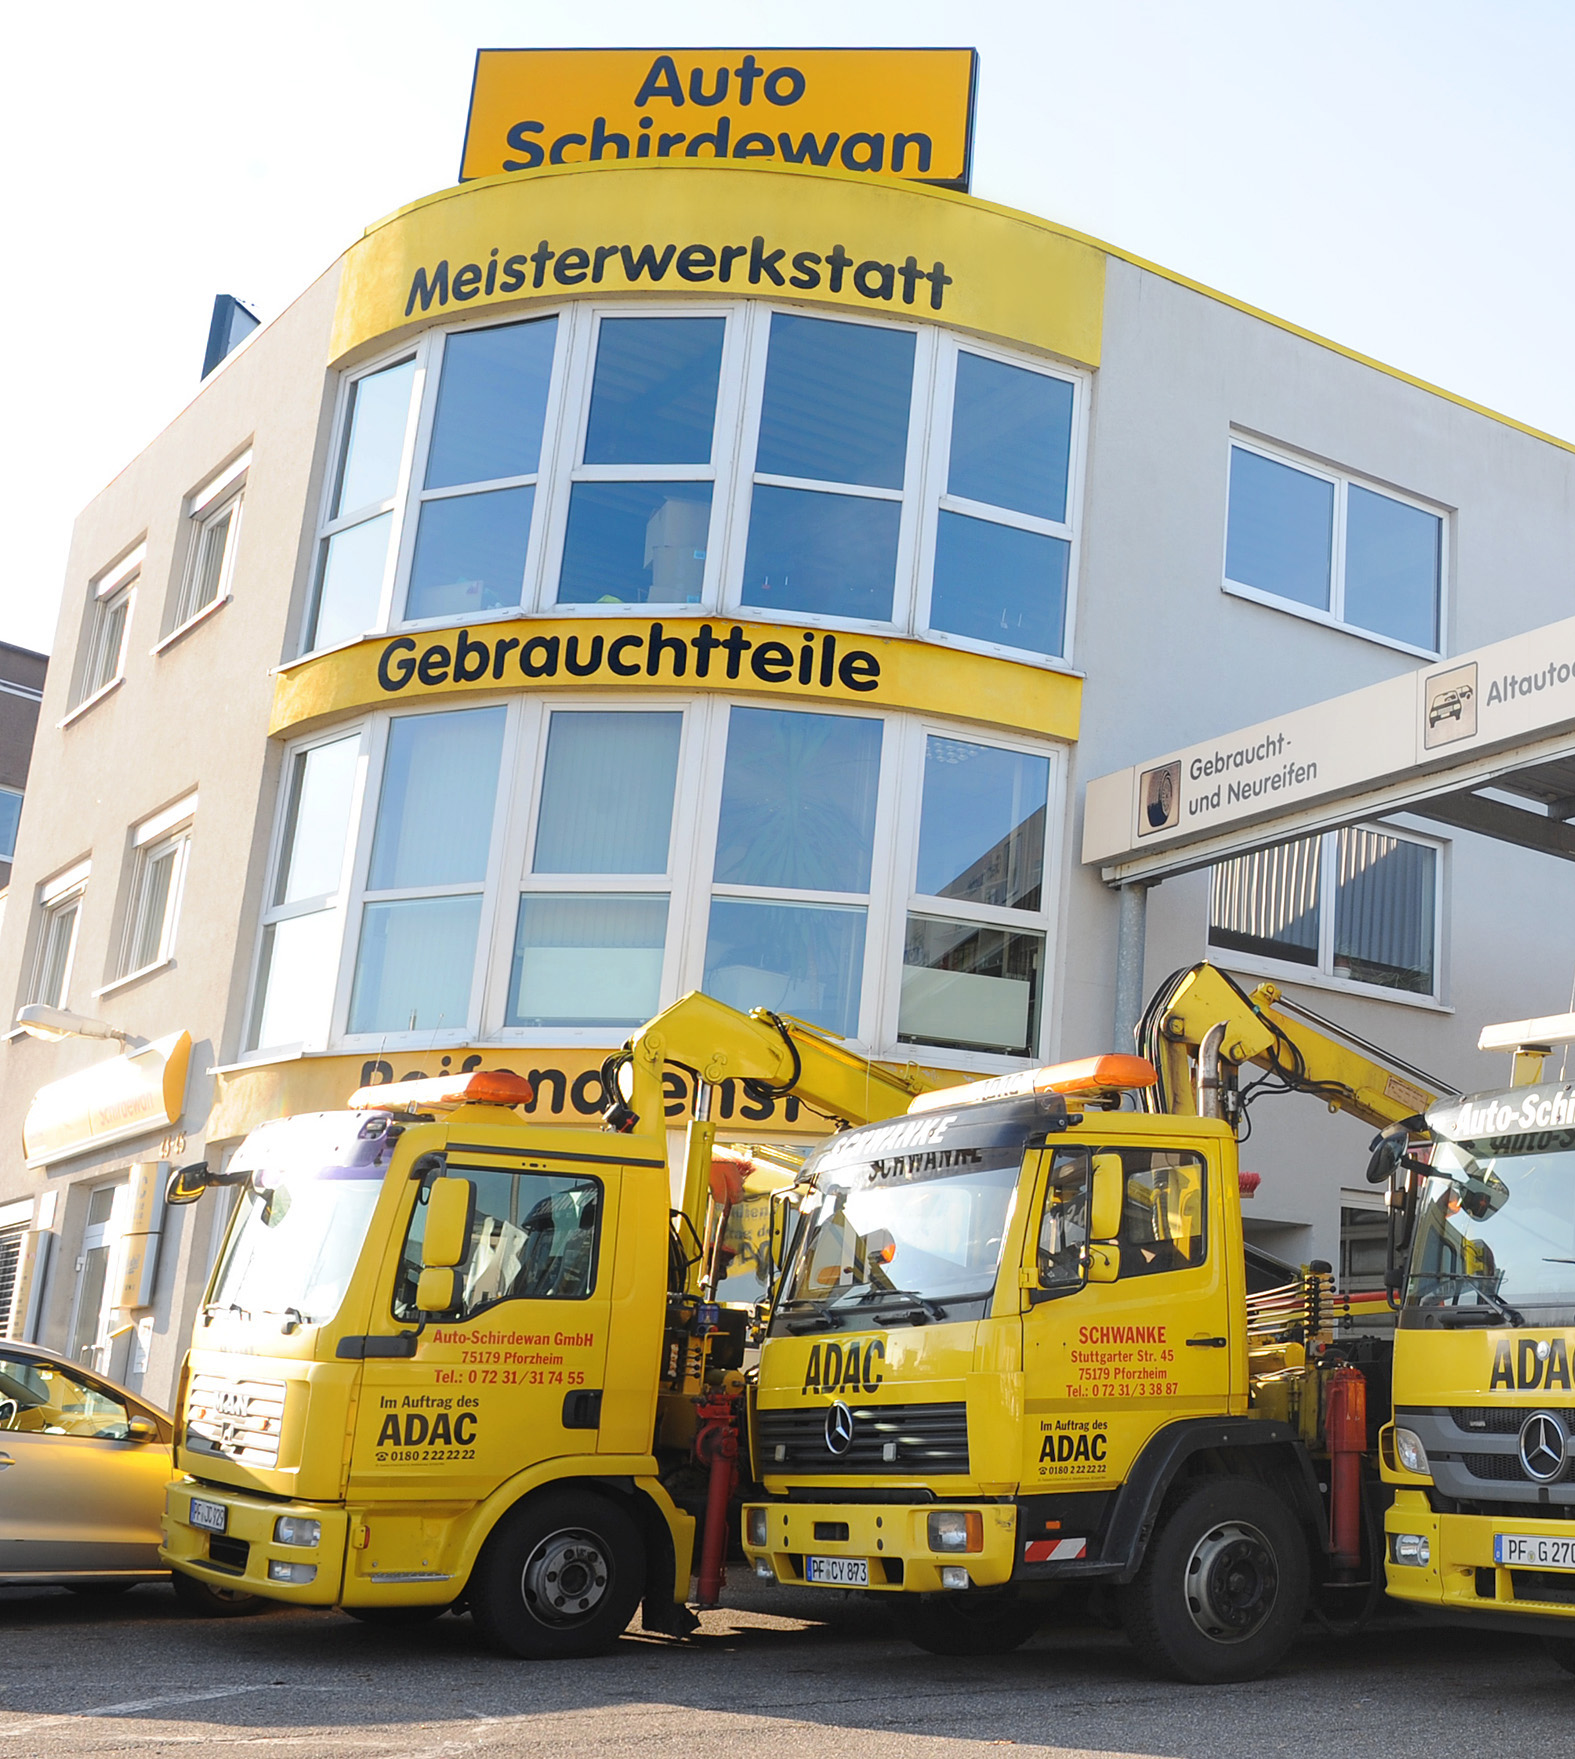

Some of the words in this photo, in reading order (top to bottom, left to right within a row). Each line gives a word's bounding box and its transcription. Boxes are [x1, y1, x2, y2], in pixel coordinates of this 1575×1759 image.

[633, 54, 806, 108] Auto
[502, 115, 933, 173] Schirdewan
[404, 235, 953, 317] Meisterwerkstatt
[377, 622, 882, 693] Gebrauchtteile
[1190, 732, 1292, 781] Gebraucht-
[1189, 784, 1221, 816] und
[1227, 762, 1317, 805] Neureifen
[832, 1115, 958, 1156] SCHWANKE
[433, 1329, 550, 1346] Auto-Schirdewan
[554, 1332, 594, 1347] GmbH
[1078, 1326, 1167, 1345] SCHWANKE
[462, 1351, 501, 1364] 75179
[503, 1352, 563, 1365] Pforzheim
[801, 1339, 885, 1396] ADAC
[1071, 1350, 1134, 1365] Stuttgarter
[1137, 1349, 1157, 1362] Str.
[1160, 1349, 1174, 1362] 45
[434, 1369, 463, 1383] Tel.:
[468, 1370, 477, 1383] 0
[482, 1370, 498, 1384] 72
[548, 1371, 563, 1384] 74
[567, 1371, 585, 1385] 55
[1078, 1367, 1110, 1381] 75179
[1114, 1367, 1167, 1380] Pforzheim
[1066, 1384, 1088, 1397] Tel.:
[1092, 1384, 1099, 1397] 0
[1102, 1384, 1115, 1397] 72
[1149, 1382, 1162, 1395] 38
[1165, 1382, 1179, 1395] 87
[380, 1395, 397, 1409] Im
[401, 1395, 453, 1410] Auftrag
[457, 1395, 479, 1408] des
[376, 1412, 478, 1447] ADAC
[1040, 1420, 1052, 1431] Im
[1055, 1420, 1090, 1432] Auftrag
[1092, 1419, 1108, 1430] des
[390, 1451, 420, 1461] 0180
[1038, 1433, 1107, 1463] ADAC
[1048, 1465, 1069, 1475] 0180
[1508, 1539, 1527, 1561] PF
[1538, 1541, 1548, 1562] G
[812, 1560, 825, 1579] PF
[831, 1561, 845, 1581] CY
[847, 1562, 867, 1582] 873
